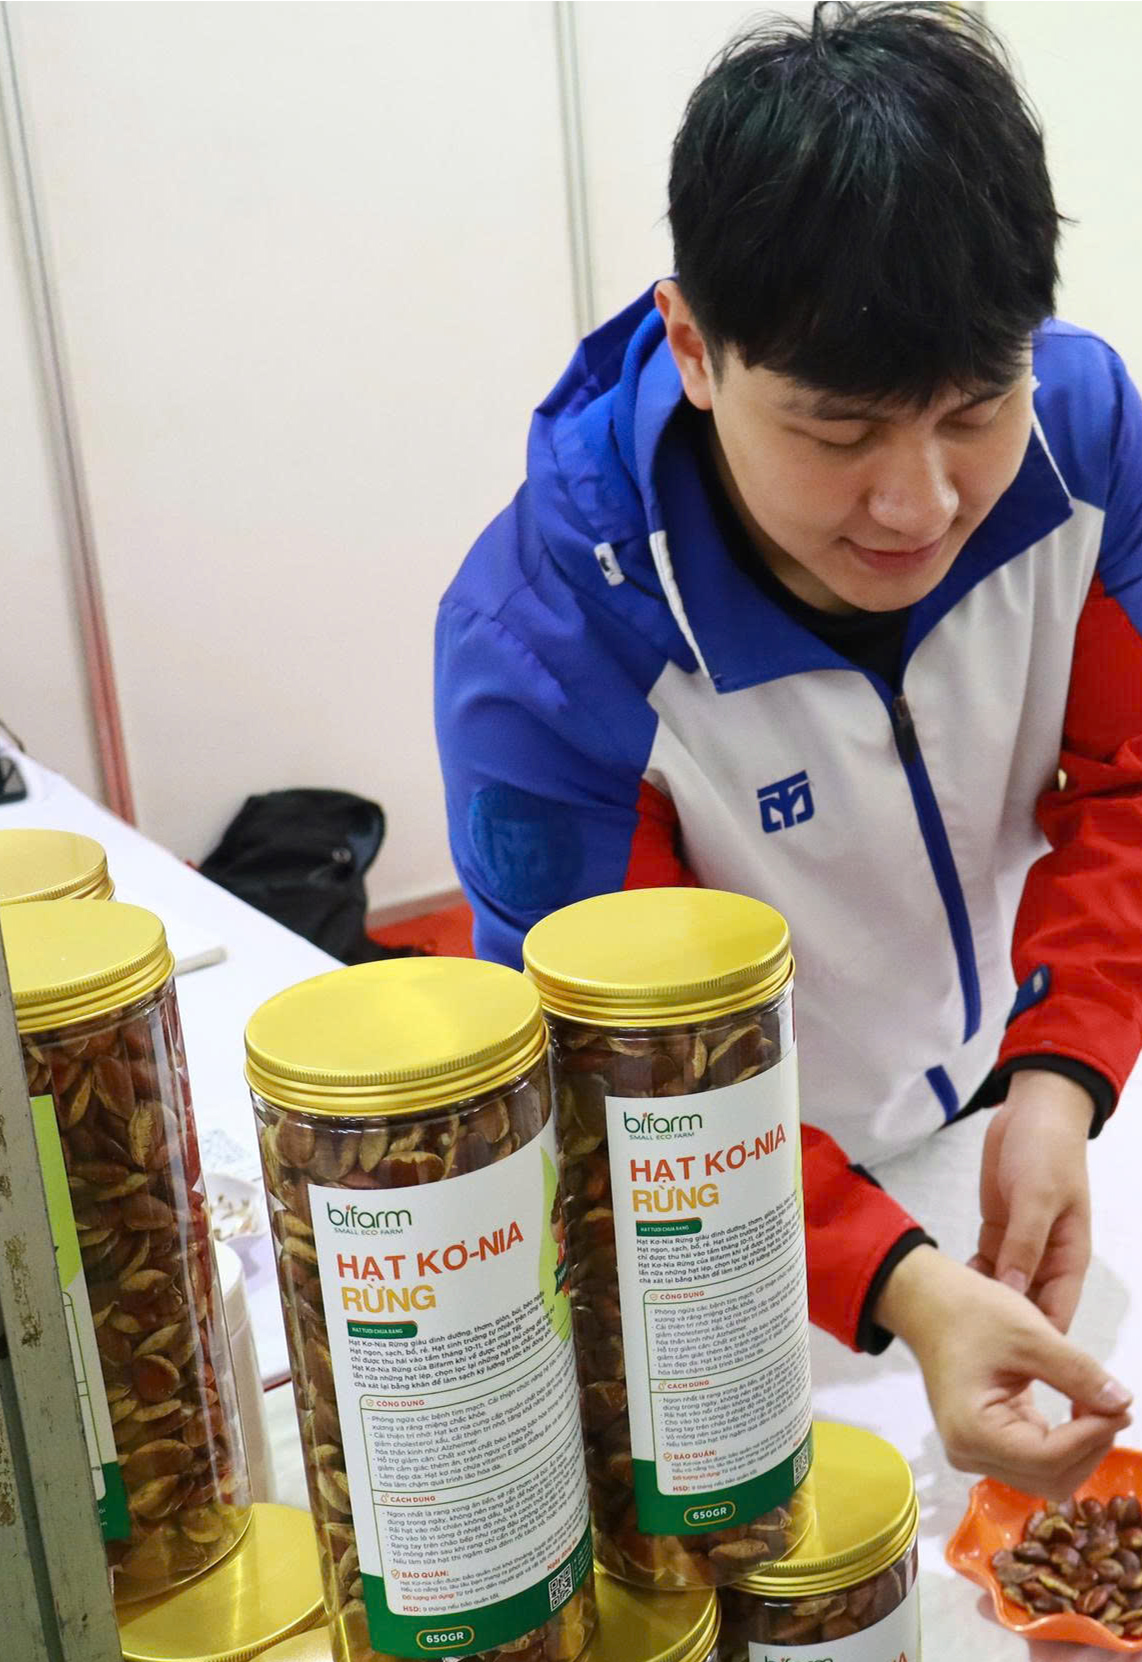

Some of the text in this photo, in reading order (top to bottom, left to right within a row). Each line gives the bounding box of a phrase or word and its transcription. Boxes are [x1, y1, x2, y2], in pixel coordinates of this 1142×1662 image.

[624, 1112, 703, 1133] bifarm
[630, 1123, 786, 1183] HẠT KƠ-NIA
[632, 1183, 720, 1213] RỪNG
[327, 1202, 412, 1228] bifarm
[337, 1253, 406, 1282] HẠT
[416, 1221, 524, 1277] KƠ-NIA
[341, 1283, 436, 1313] RỪNG
[692, 1507, 728, 1520] 650GR
[426, 1631, 464, 1644] 650GR
